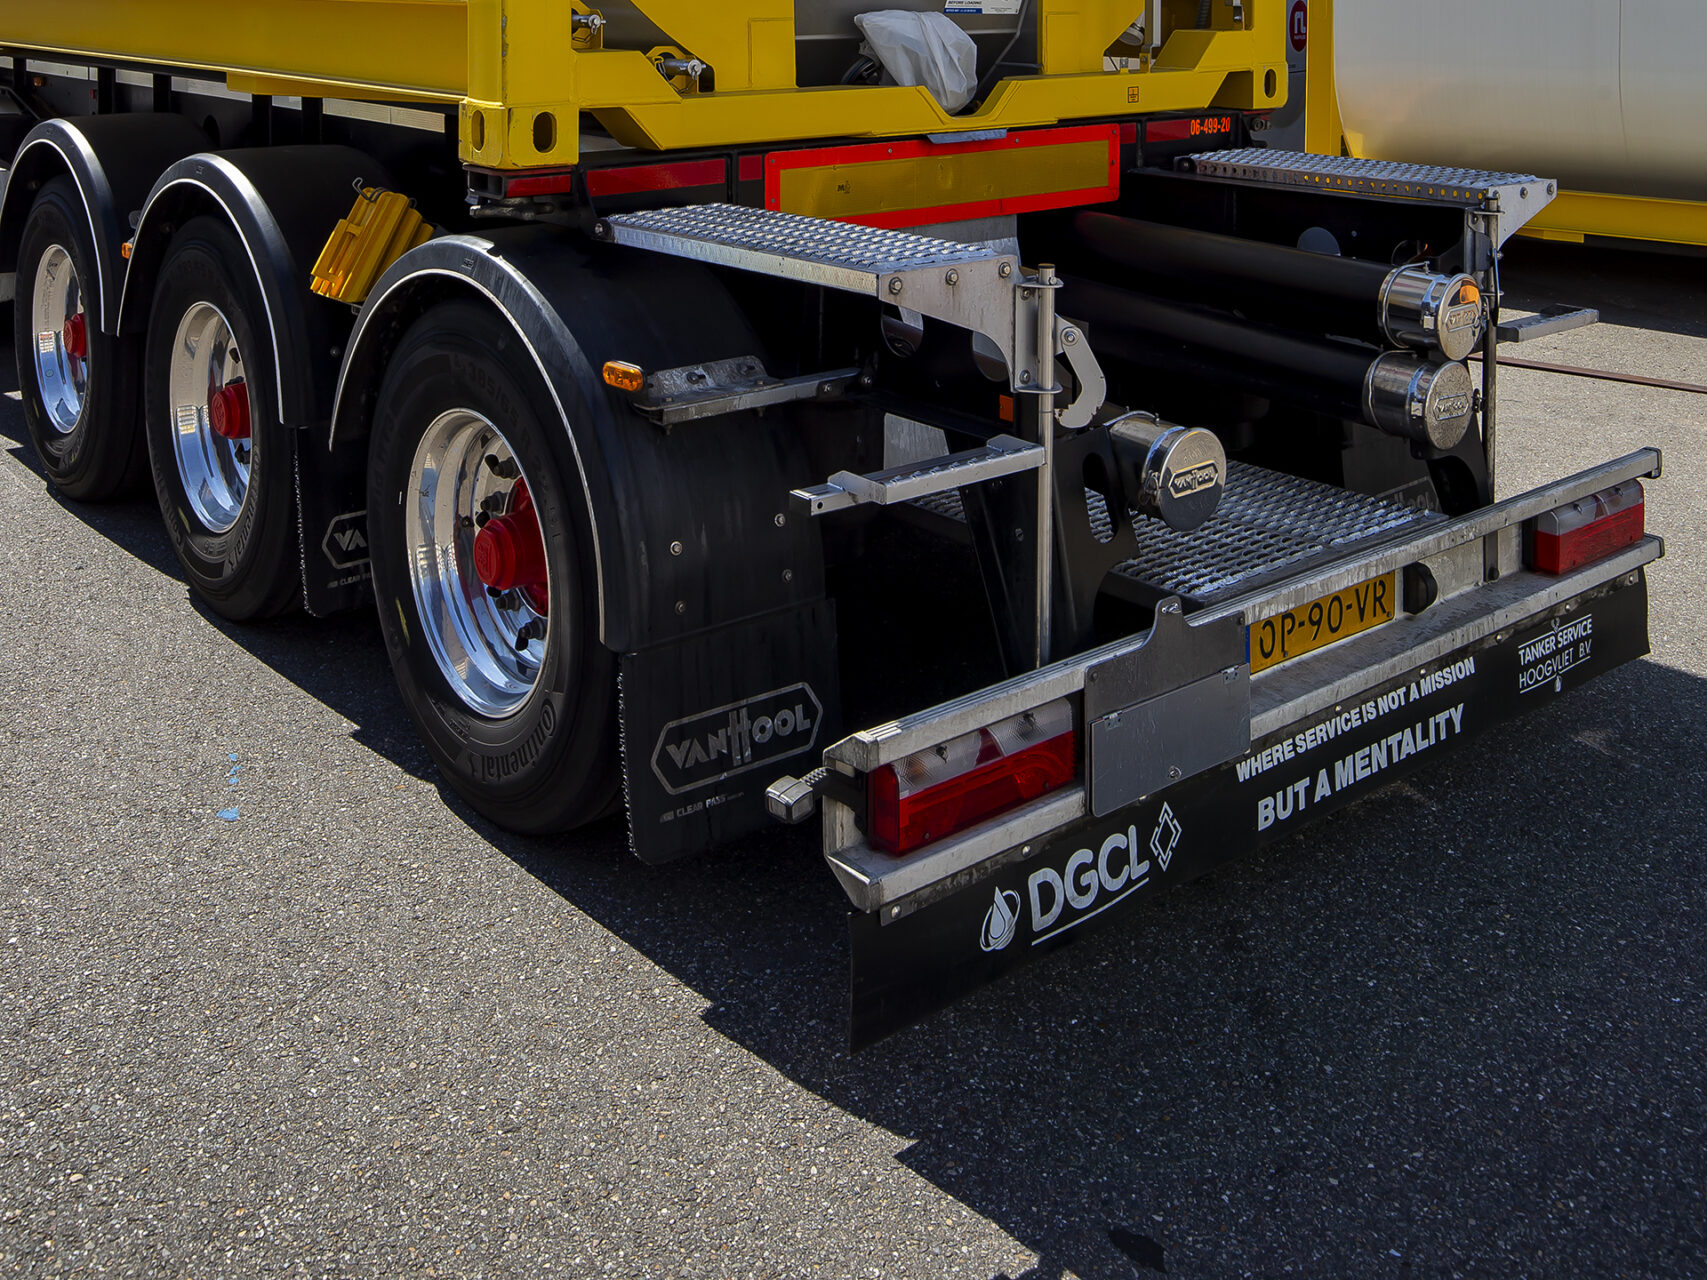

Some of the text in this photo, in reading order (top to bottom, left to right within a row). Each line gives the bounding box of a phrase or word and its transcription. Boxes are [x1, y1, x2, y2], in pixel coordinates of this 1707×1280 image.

[1190, 116, 1231, 136] 06-499-20
[1260, 579, 1387, 659] OP-90-VR
[1518, 618, 1592, 666] TANKER SERVICE
[1519, 647, 1574, 688] HOOGVLIET
[481, 698, 557, 782] Continental
[1236, 656, 1476, 783] WHERE SERVICE IS NOT A MISSION
[676, 800, 703, 818] CLEAR
[705, 794, 726, 808] PASS
[1258, 703, 1465, 832] BUT A MENTALITY
[1028, 824, 1150, 933] DGCL
